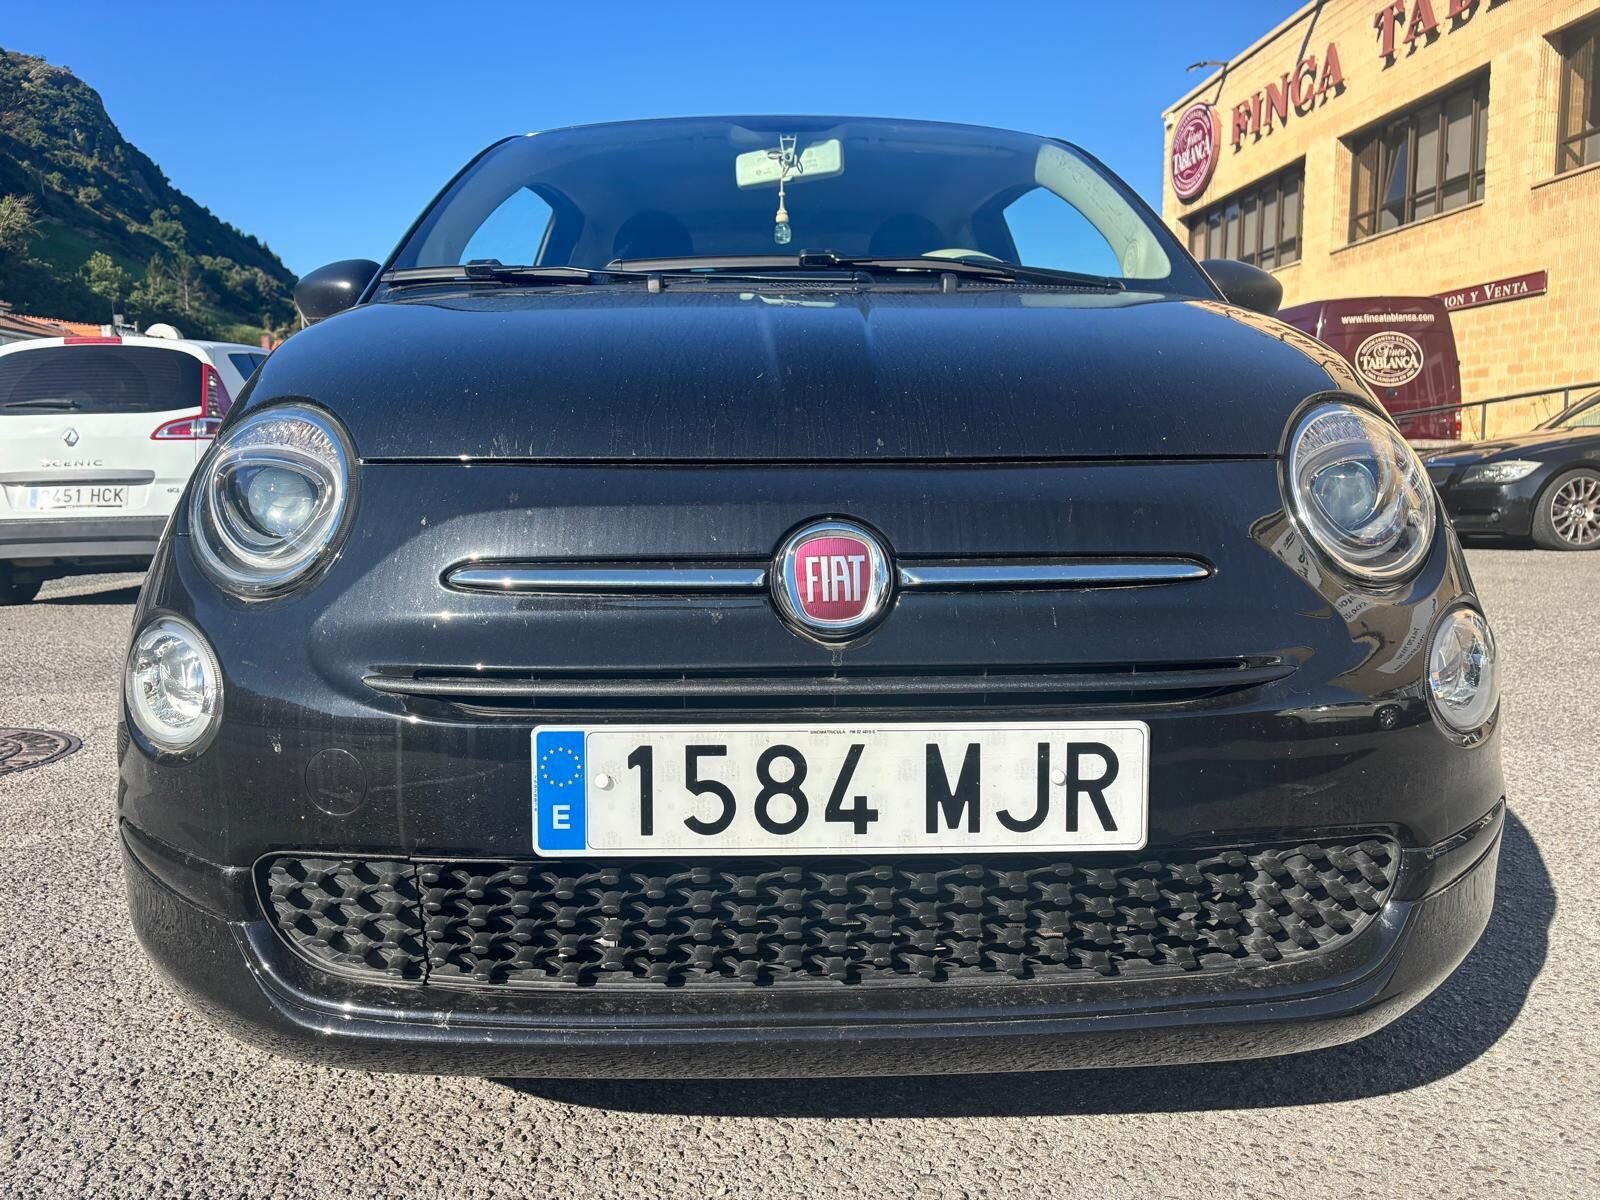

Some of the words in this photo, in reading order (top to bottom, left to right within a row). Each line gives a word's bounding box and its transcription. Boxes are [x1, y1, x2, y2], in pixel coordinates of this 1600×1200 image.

[1230, 42, 1344, 145] FINCA
[1470, 291, 1479, 303] Y
[1341, 313, 1435, 325] www.fincatablanca.com
[1360, 353, 1420, 370] TABLANCA
[41, 459, 104, 467] SCENIC
[90, 487, 124, 503] HCK
[806, 555, 865, 603] FIAT
[627, 743, 879, 837] 1584
[925, 742, 1121, 834] MJR
[552, 804, 571, 830] E
